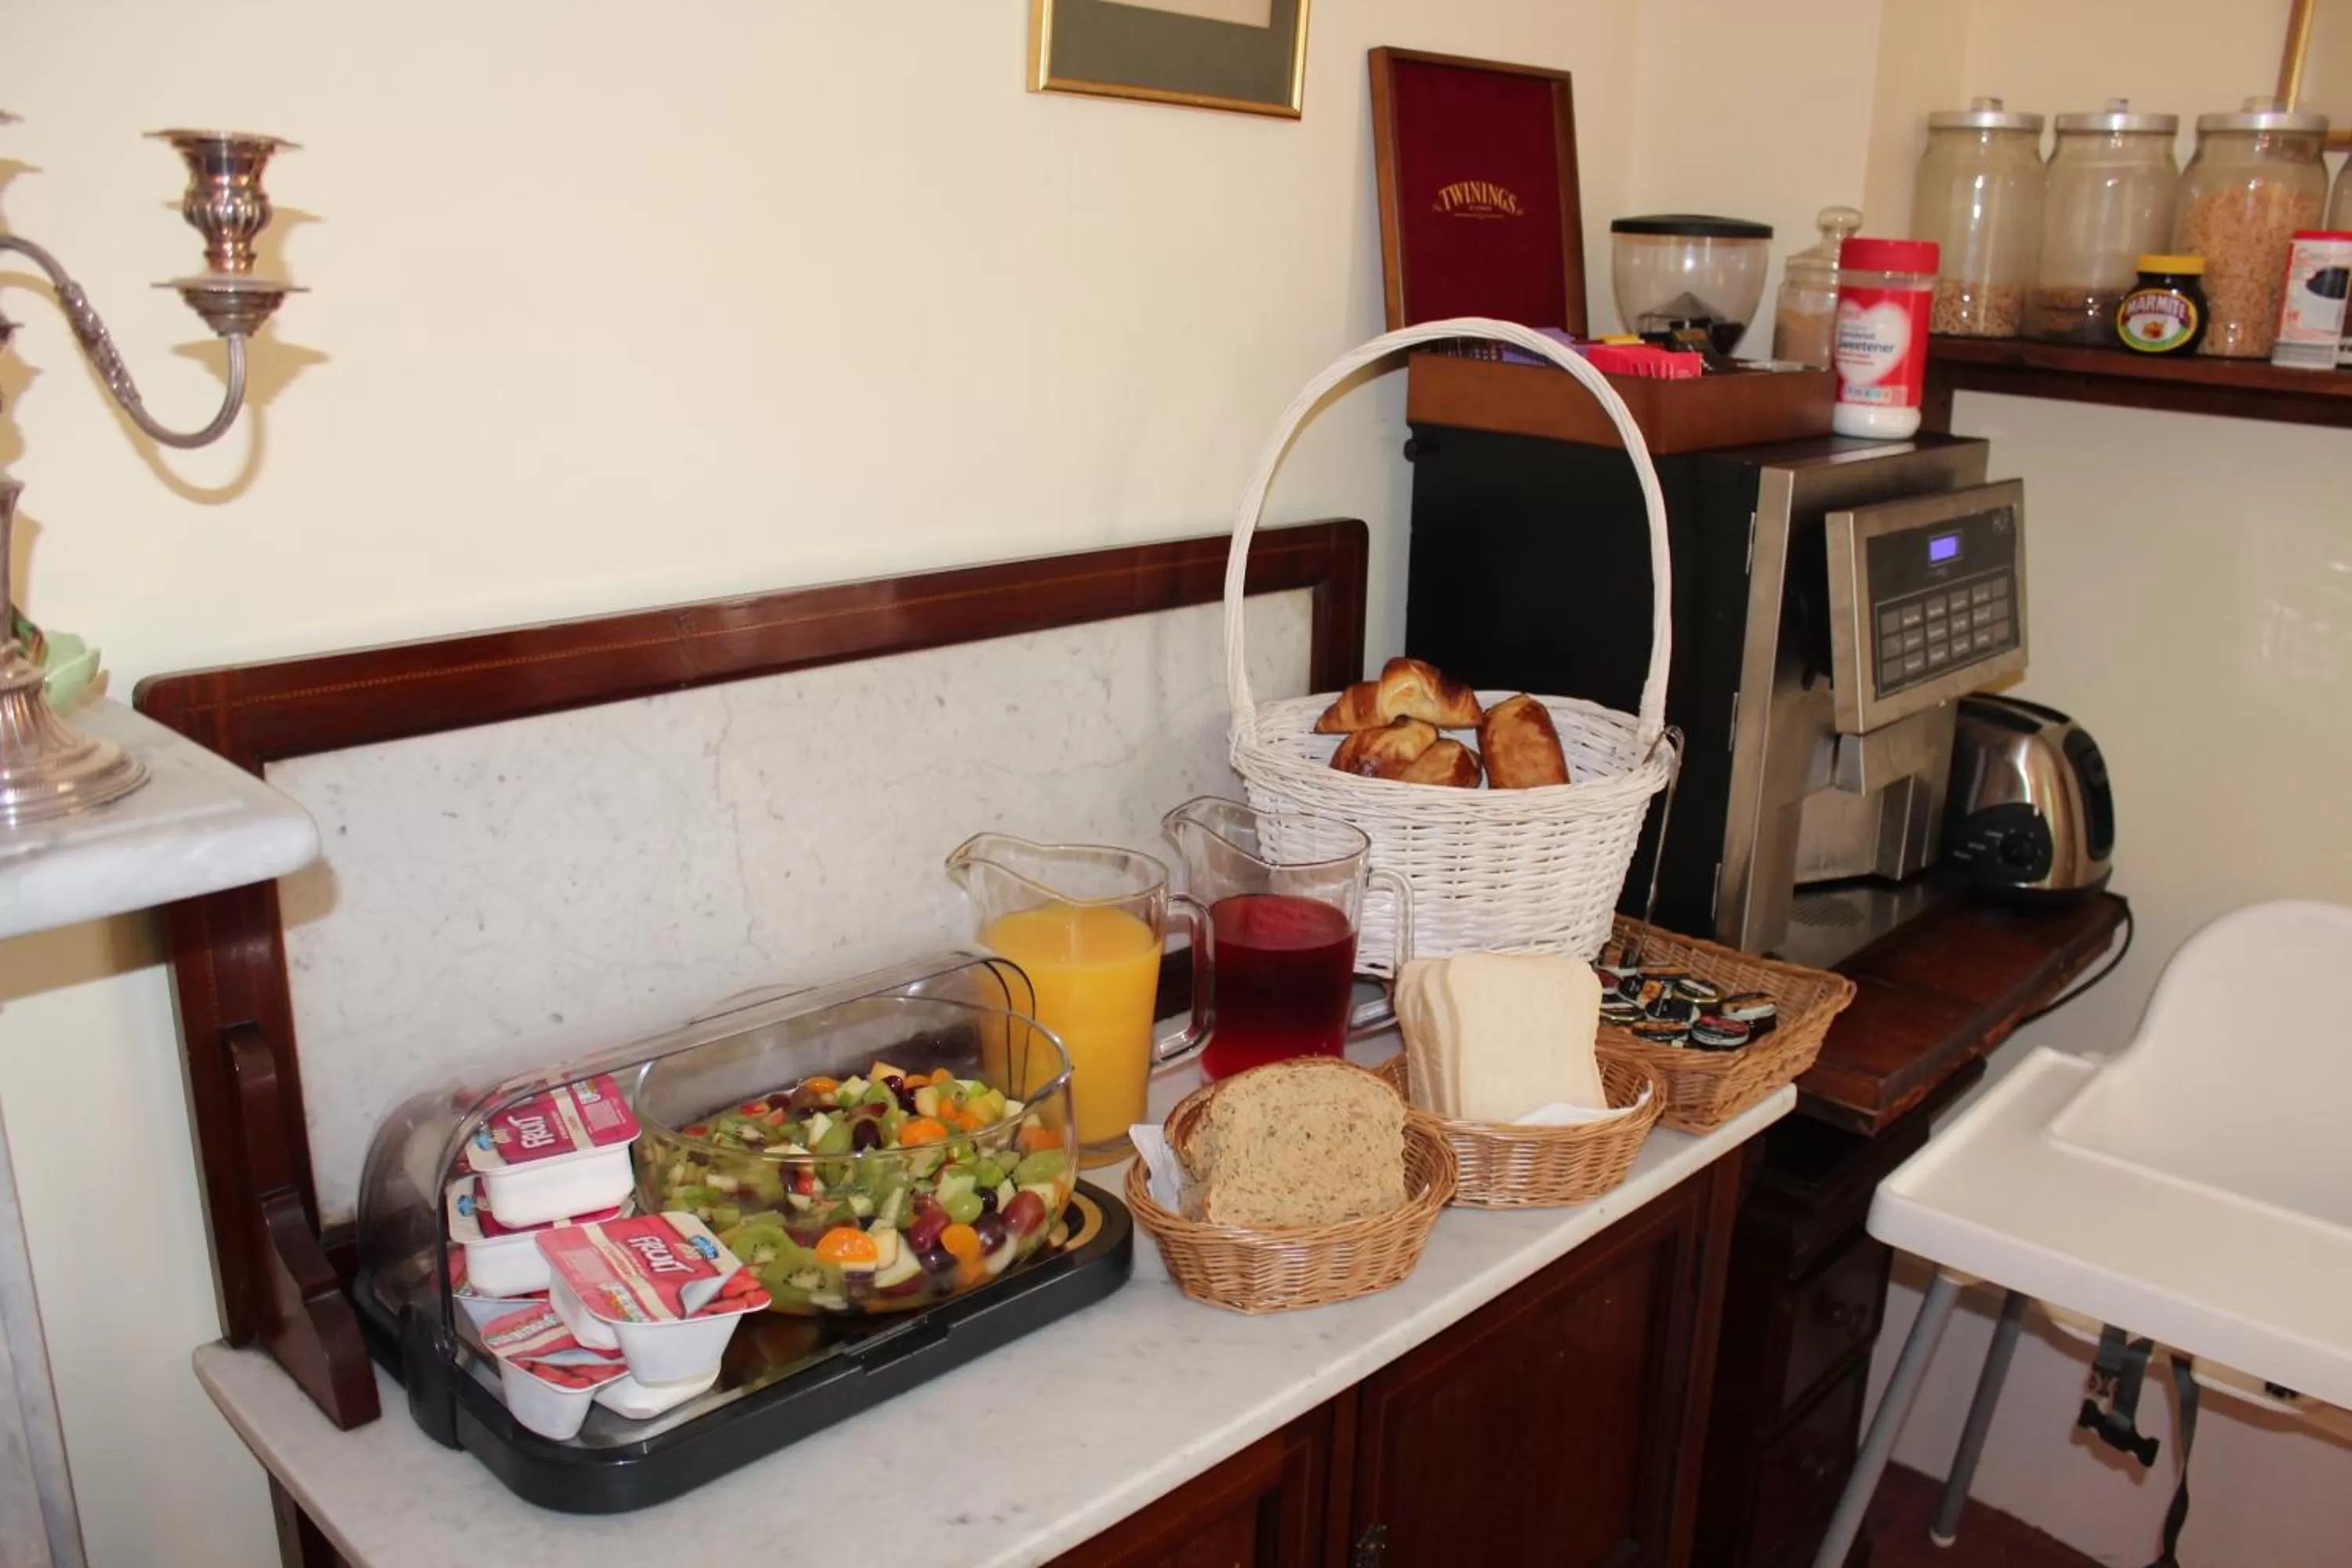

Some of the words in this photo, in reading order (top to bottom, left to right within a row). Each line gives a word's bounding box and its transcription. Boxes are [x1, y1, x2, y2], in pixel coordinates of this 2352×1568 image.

[1439, 180, 1518, 214] TWININGS
[2126, 294, 2187, 319] MARMITE
[506, 1115, 556, 1149] FRUIT
[627, 1235, 695, 1273] FRUIT
